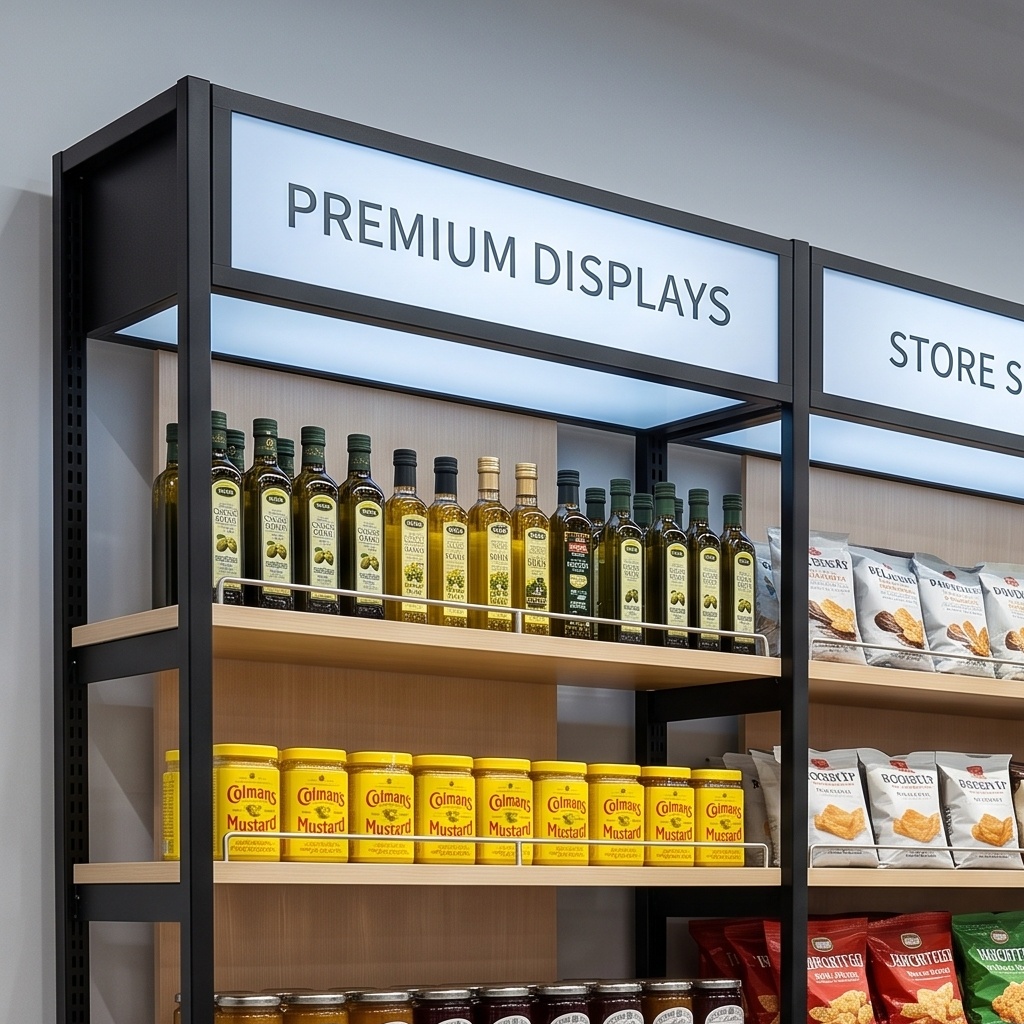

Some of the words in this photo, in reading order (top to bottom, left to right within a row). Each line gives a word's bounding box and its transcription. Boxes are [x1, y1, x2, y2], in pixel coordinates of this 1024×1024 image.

[288, 182, 516, 278] PREMIUM
[534, 242, 731, 326] DISPLAYS
[889, 331, 995, 390] STORE
[227, 814, 276, 832] Mustard
[297, 816, 345, 834] Mustard
[429, 820, 473, 837] Mustard
[603, 824, 641, 840] Mustard
[656, 826, 693, 841] Mustard
